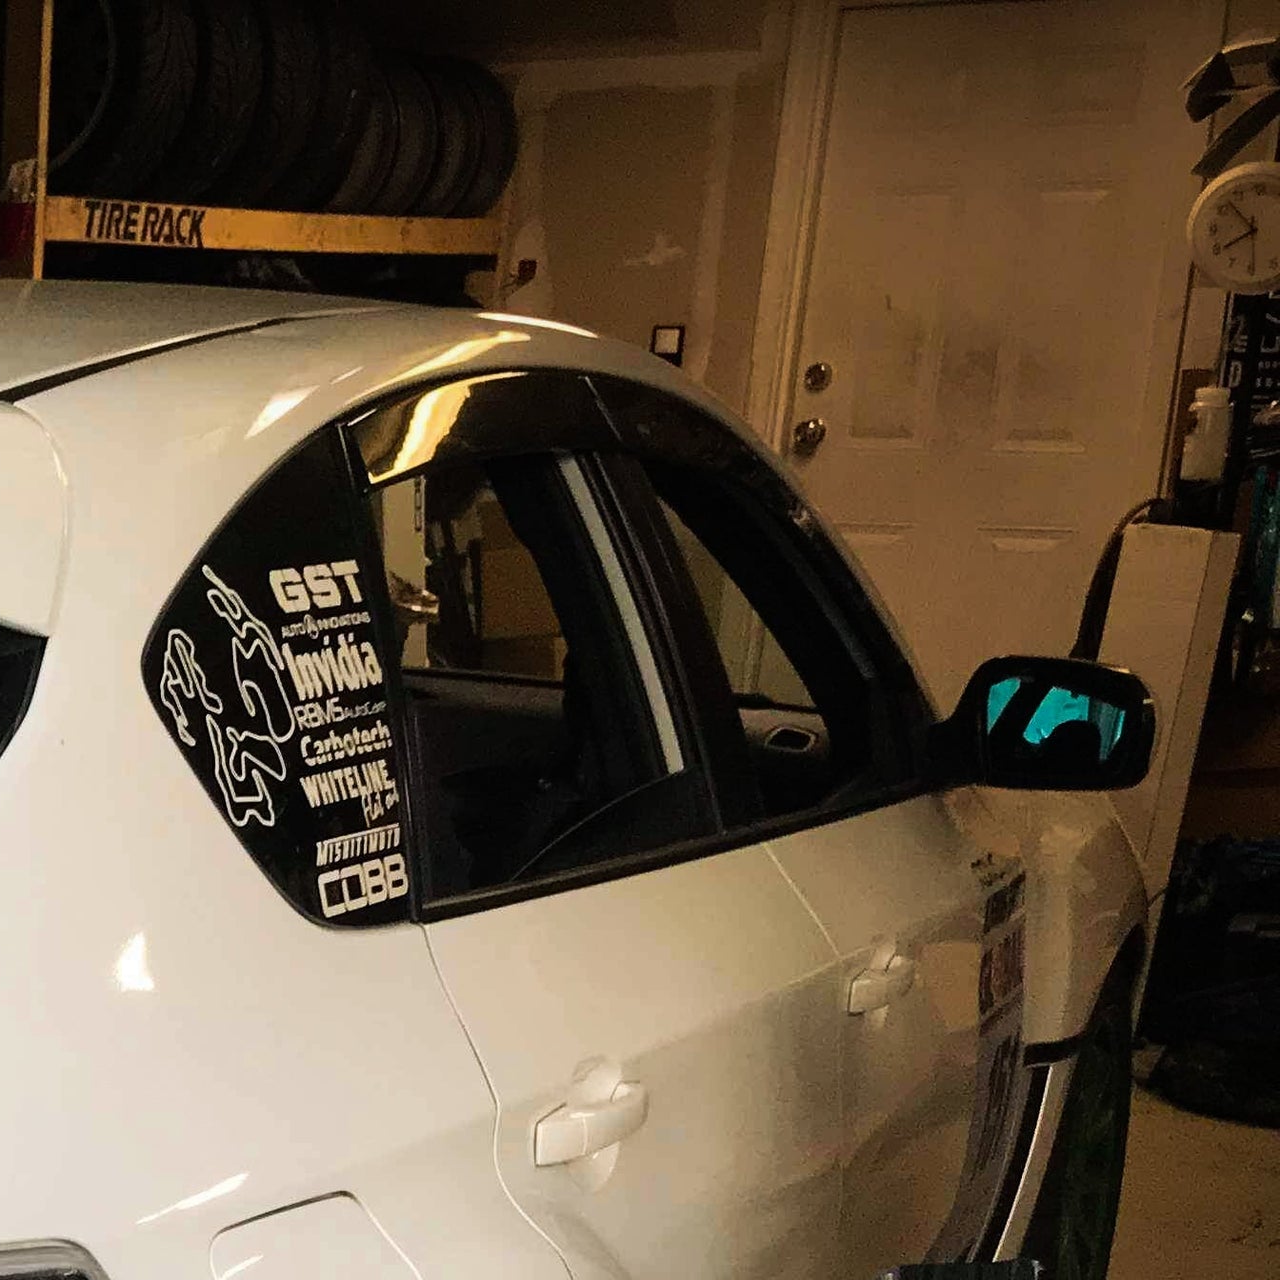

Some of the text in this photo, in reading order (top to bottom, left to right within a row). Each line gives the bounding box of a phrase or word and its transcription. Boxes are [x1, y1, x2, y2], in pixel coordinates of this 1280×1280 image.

[84, 199, 206, 249] TIRE RACK
[269, 559, 364, 614] GST
[281, 633, 383, 701] Invidia
[300, 720, 393, 766] Carbotech
[299, 759, 389, 808] WHITELINE
[317, 852, 409, 918] COBB
